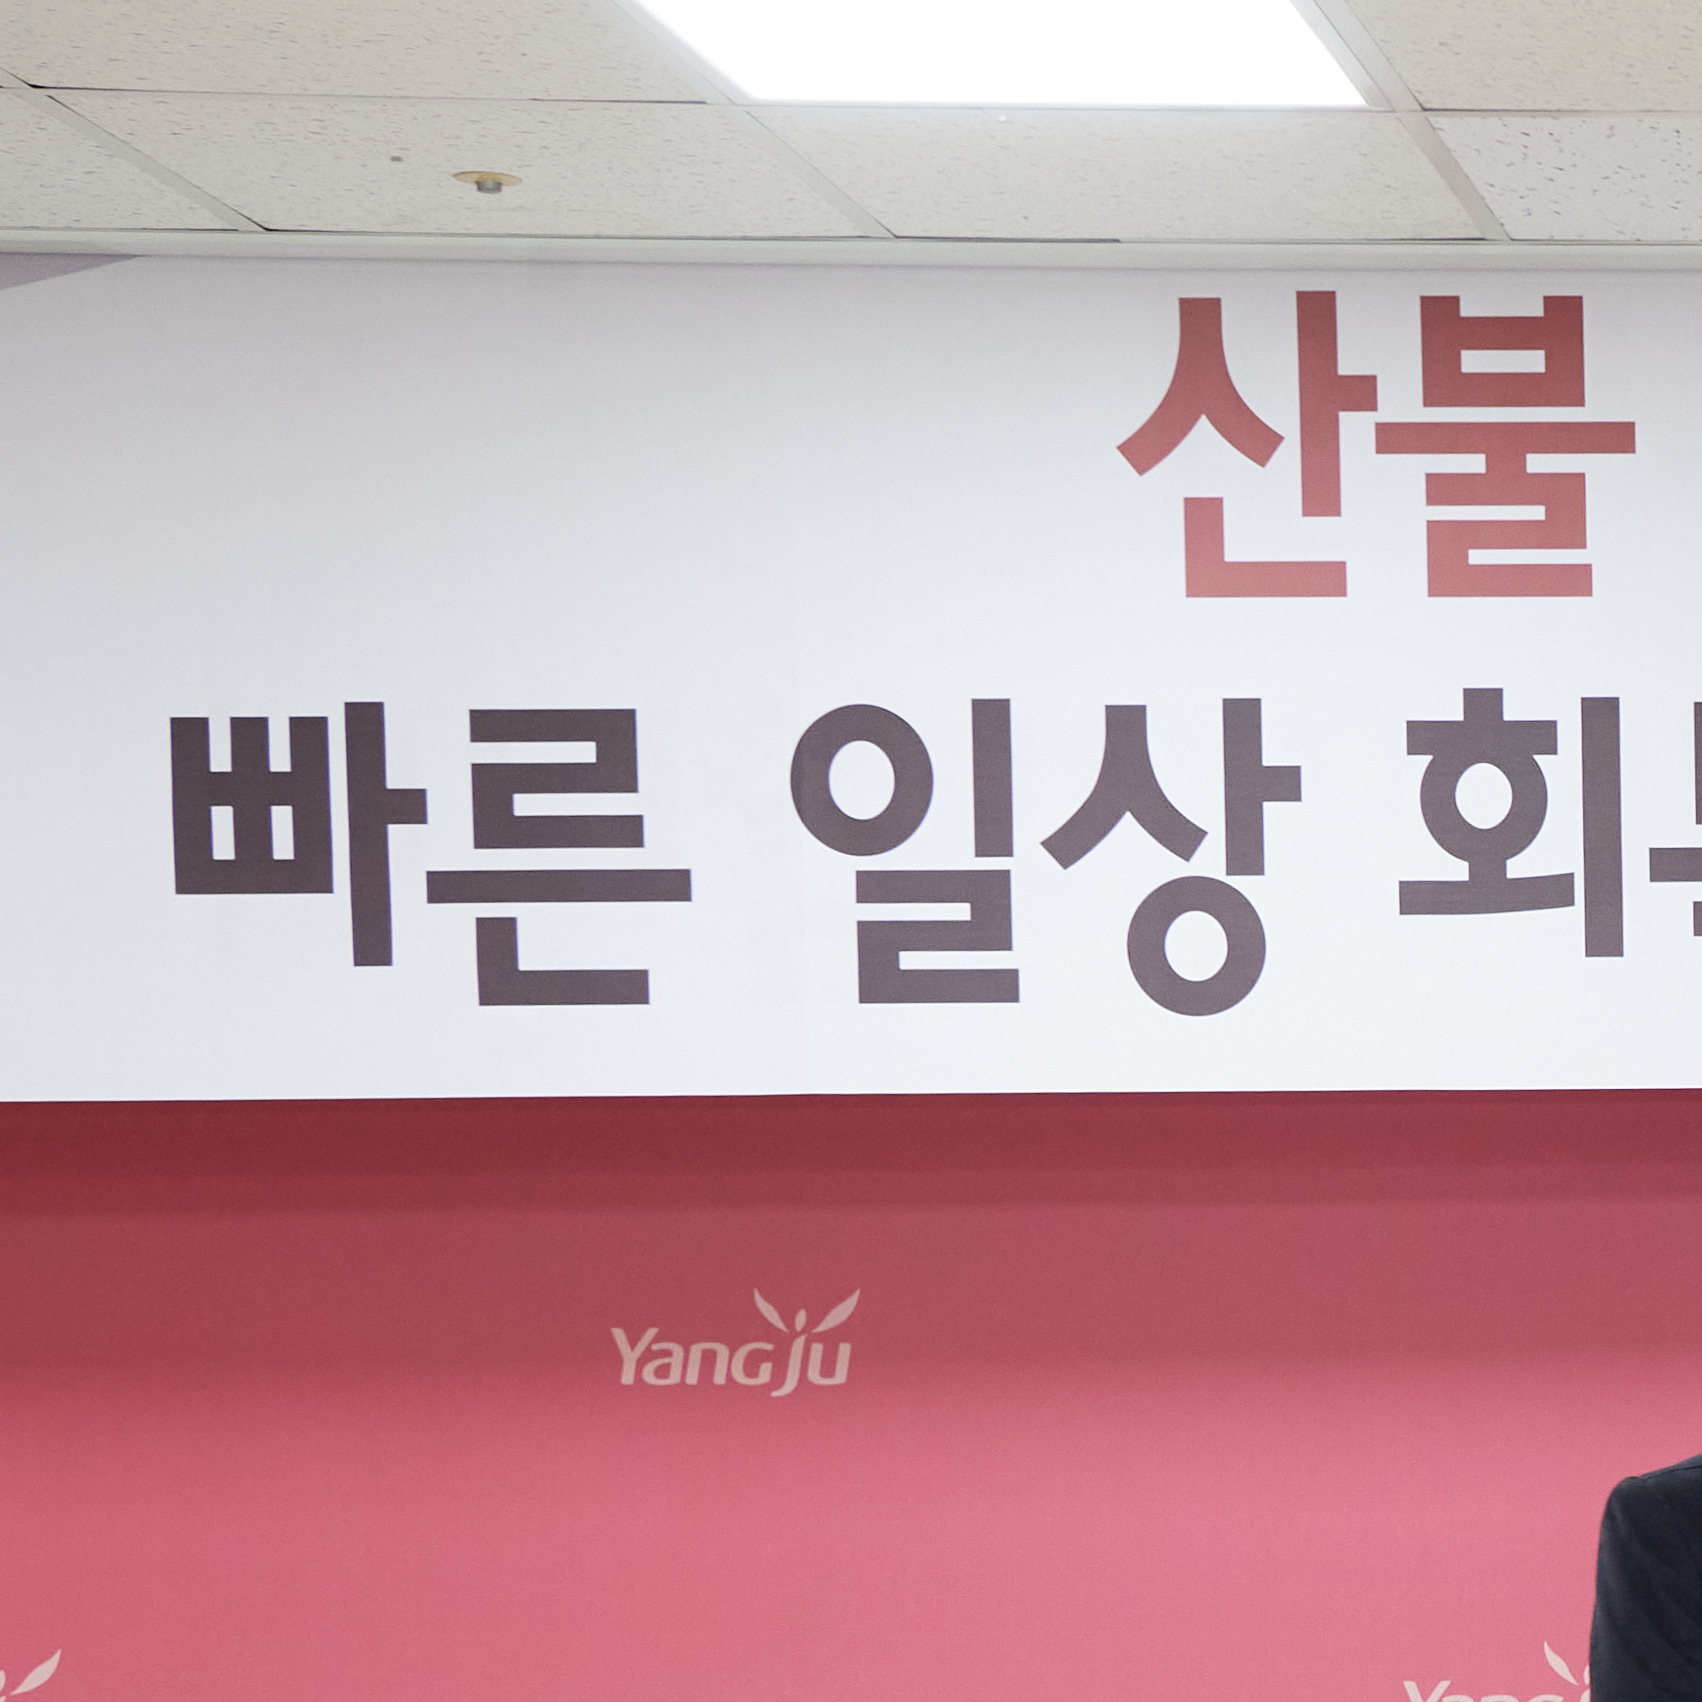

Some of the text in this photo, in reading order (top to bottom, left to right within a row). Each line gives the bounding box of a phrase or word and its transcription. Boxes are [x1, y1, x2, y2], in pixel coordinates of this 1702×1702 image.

[1117, 290, 1637, 598] 산불
[170, 702, 692, 1006] 빠른
[790, 698, 1301, 1016] 일상
